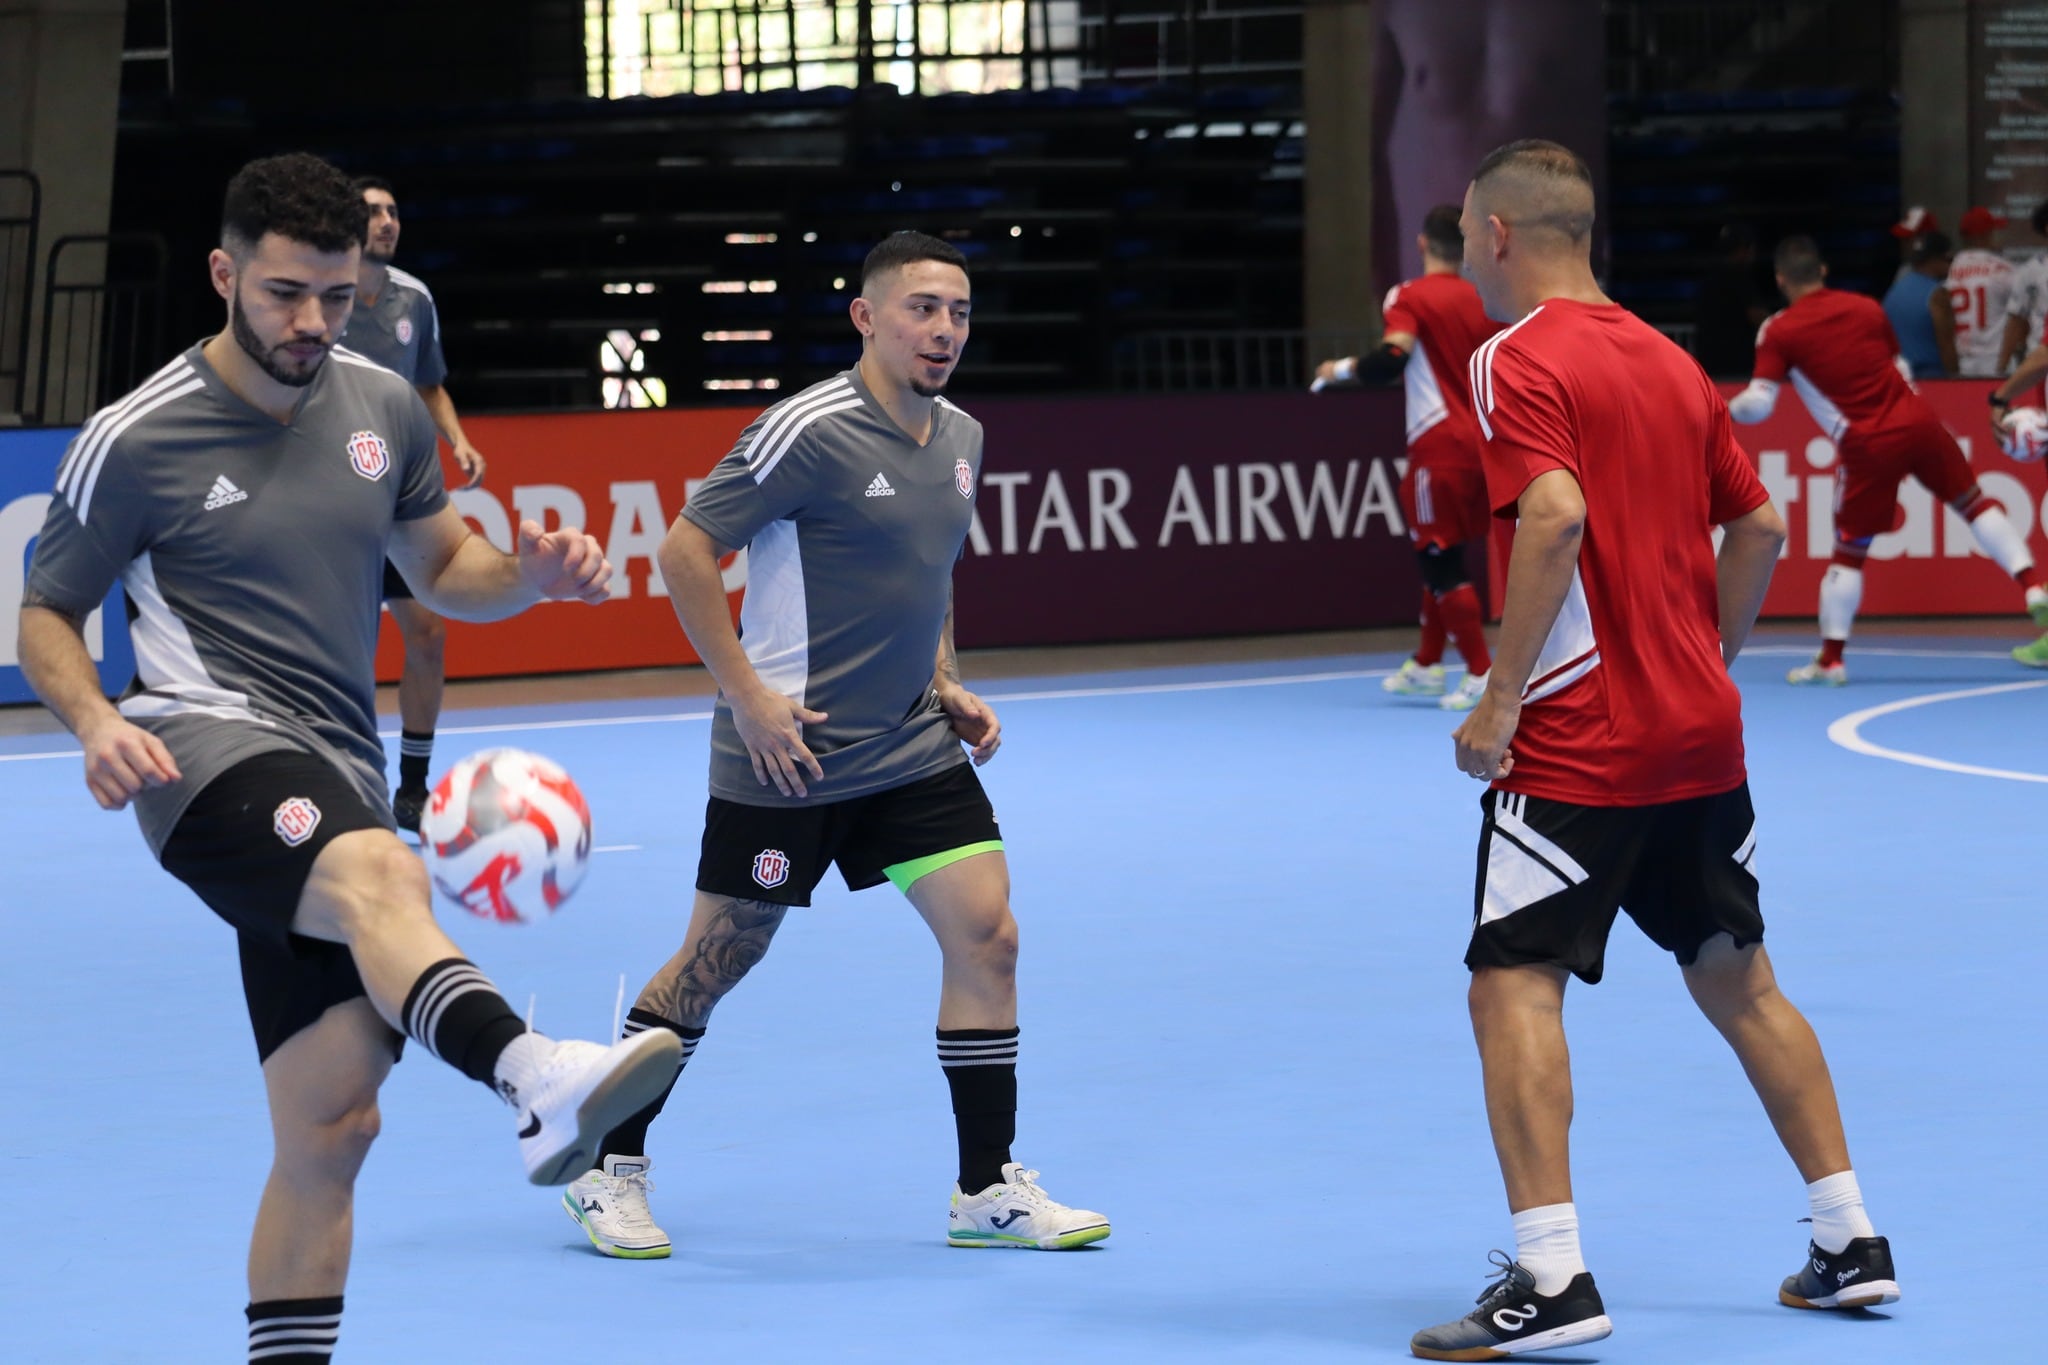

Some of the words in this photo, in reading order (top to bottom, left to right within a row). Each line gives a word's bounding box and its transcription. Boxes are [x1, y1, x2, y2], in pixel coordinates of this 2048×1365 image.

[203, 490, 248, 511] adidas
[865, 487, 895, 497] adidas
[1158, 457, 1408, 548] AIRWA
